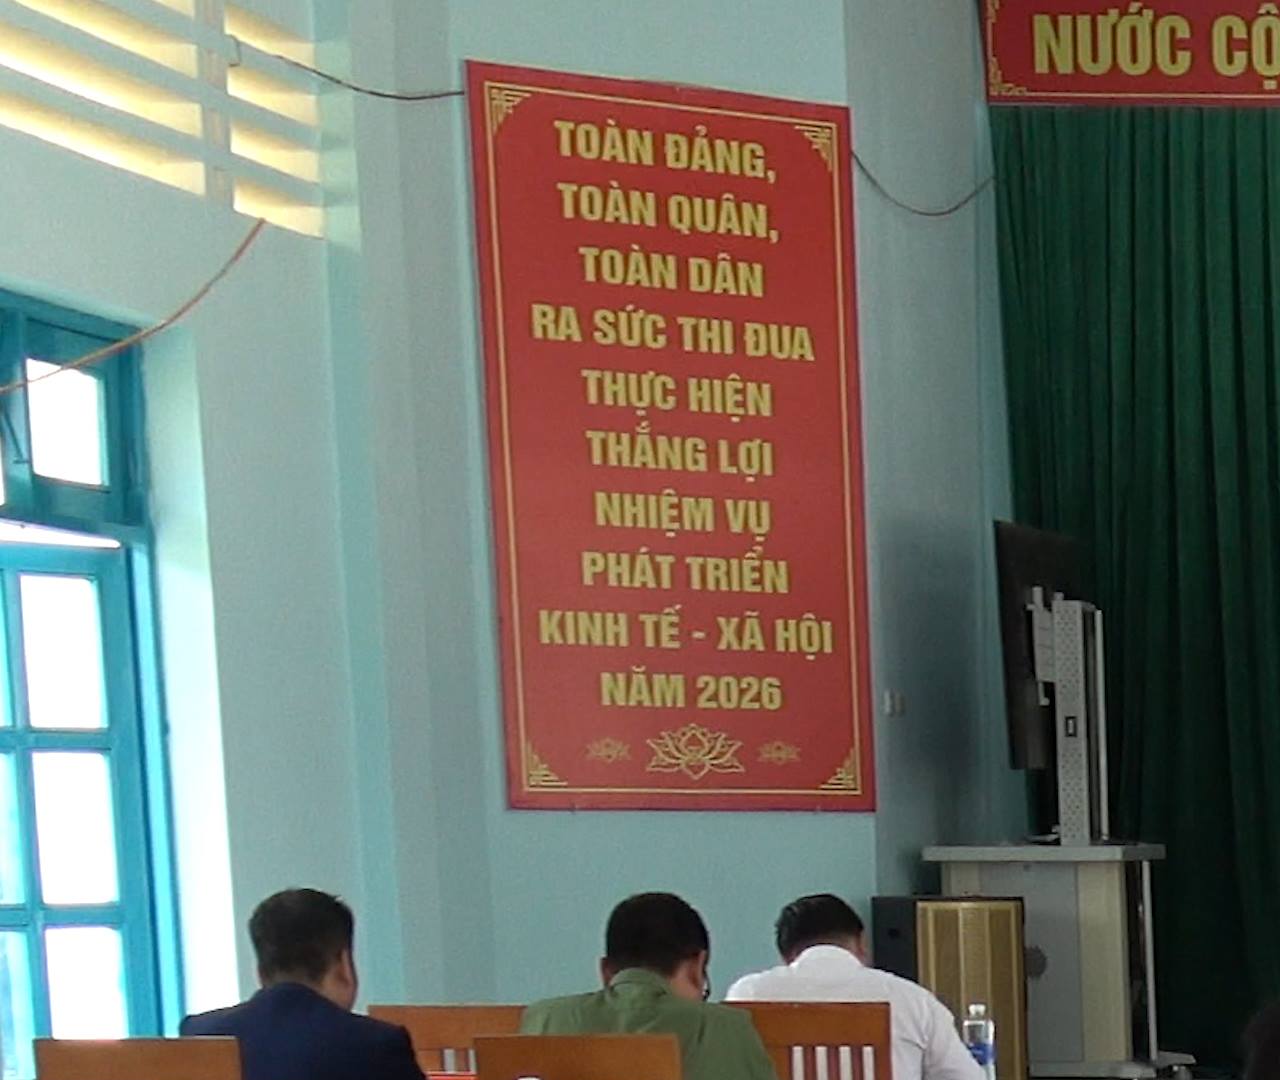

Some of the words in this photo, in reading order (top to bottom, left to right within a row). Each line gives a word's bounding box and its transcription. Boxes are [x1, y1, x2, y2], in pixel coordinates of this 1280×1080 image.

[1034, 2, 1191, 76] NƯỚC
[554, 119, 653, 165] TOÀN
[665, 125, 775, 183] ĐẢNG,
[557, 181, 656, 226] TOÀN
[668, 193, 778, 243] QUÂN,
[579, 244, 677, 289] TOÀN
[689, 253, 763, 297] DÂN
[532, 304, 582, 342] RA
[594, 305, 666, 348] SỨC
[677, 317, 733, 354] THI
[744, 323, 814, 361] ĐUA
[581, 370, 676, 416] THỰC
[688, 373, 771, 422] HIỆN
[586, 421, 707, 471] THẮNG
[719, 439, 772, 482] LỢI
[595, 489, 714, 537] NHIỆM
[725, 499, 770, 541] VỤ
[582, 547, 675, 588] PHÁT
[685, 546, 788, 593] TRIỂN
[540, 610, 628, 646] KINH
[639, 604, 681, 648] TẾ
[692, 631, 705, 639] -
[717, 611, 764, 651] XÃ
[776, 613, 832, 660] HỘI
[601, 666, 685, 707] NĂM
[697, 675, 781, 710] 2026
